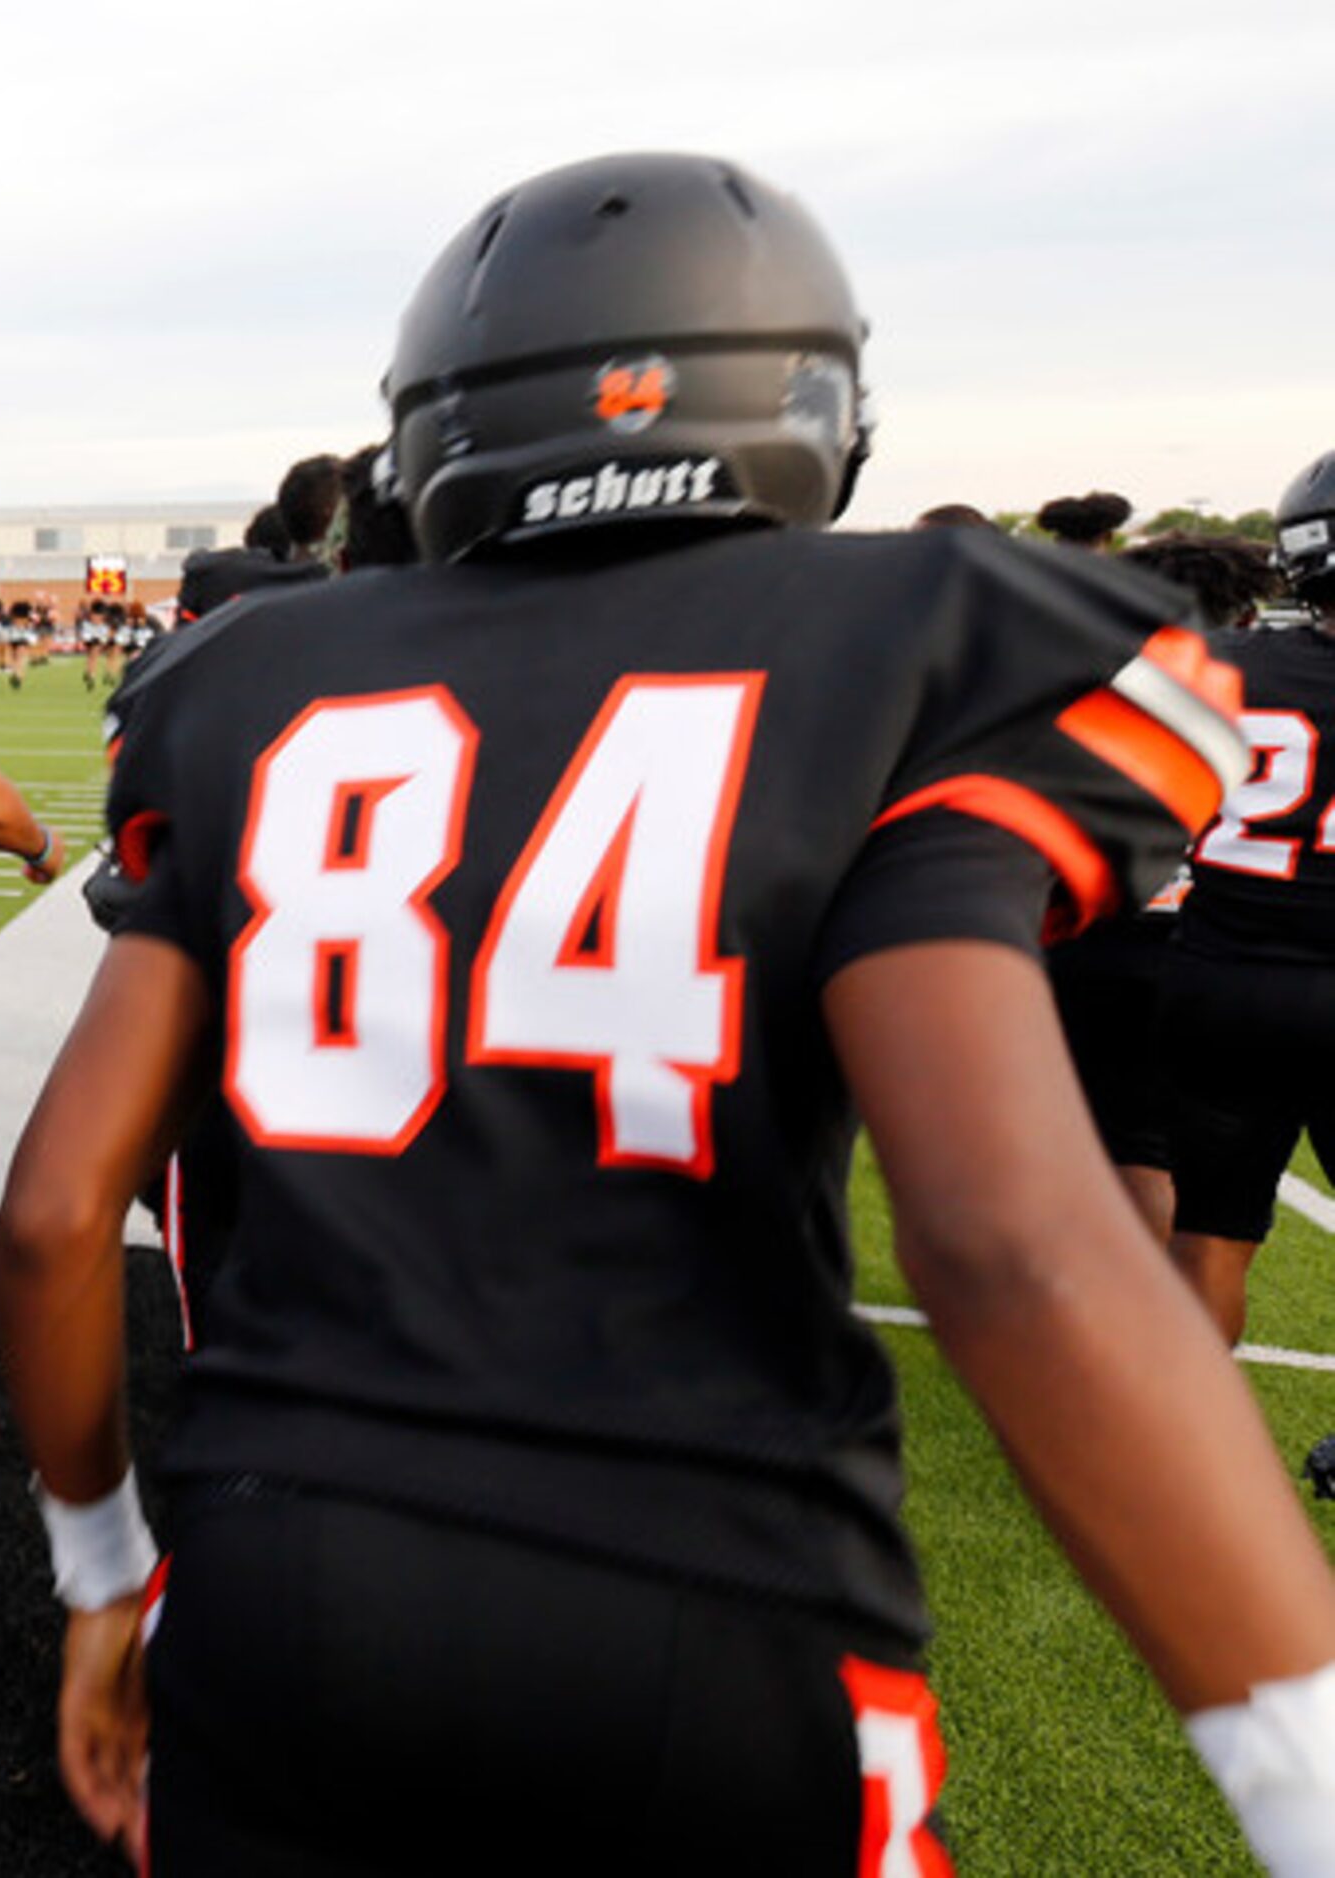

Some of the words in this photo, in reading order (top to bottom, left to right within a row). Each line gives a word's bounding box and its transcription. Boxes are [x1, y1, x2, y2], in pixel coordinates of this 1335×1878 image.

[595, 366, 666, 421] 84
[523, 456, 720, 523] schutt
[222, 669, 767, 1179] 84
